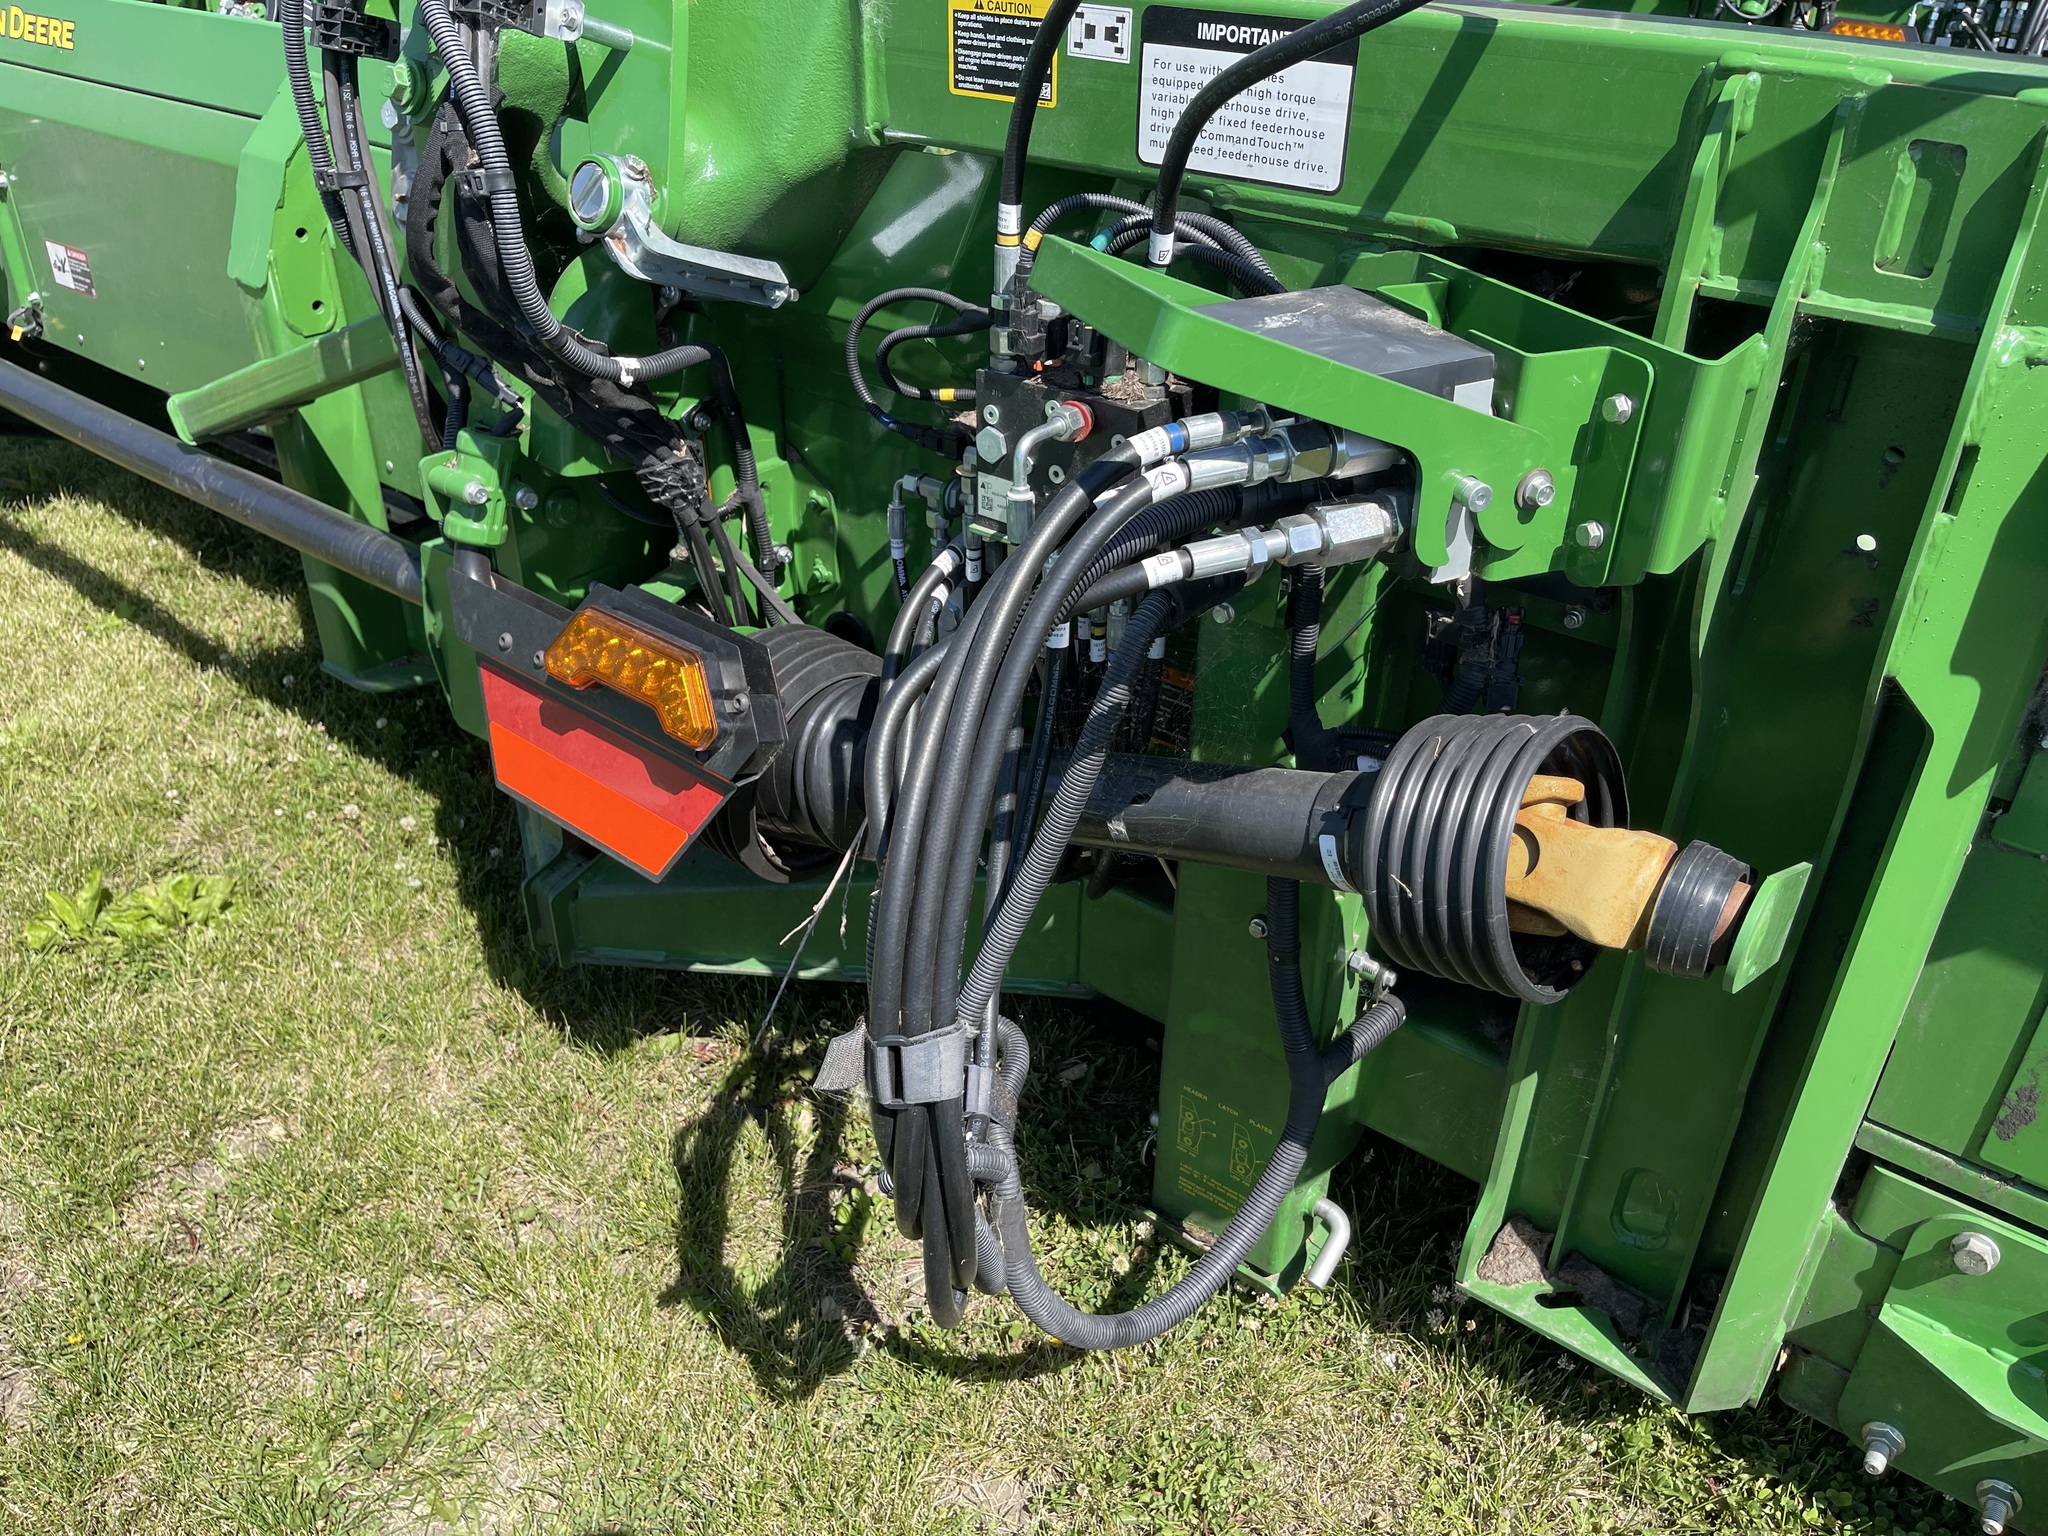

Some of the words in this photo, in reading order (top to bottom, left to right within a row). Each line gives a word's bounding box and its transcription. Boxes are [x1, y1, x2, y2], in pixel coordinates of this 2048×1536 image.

[987, 0, 1032, 15] CAUTION
[9, 5, 76, 51] DEERE
[1014, 18, 1030, 27] during
[958, 39, 987, 48] power-driven
[1006, 35, 1026, 45] clothing
[958, 48, 981, 57] Disengage
[982, 51, 1012, 60] power-driven
[1012, 53, 1024, 62] parts
[965, 57, 980, 65] engine
[981, 58, 995, 66] before
[996, 60, 1022, 70] unclogging
[1153, 58, 1172, 71] For
[1176, 63, 1195, 74] use
[1200, 64, 1224, 76] with
[958, 82, 984, 90] unattended.
[985, 78, 1003, 87] running
[1004, 80, 1019, 88] machin
[1152, 75, 1204, 91] equipped
[1246, 87, 1272, 102] high
[1277, 90, 1316, 106] torque
[1222, 100, 1271, 117] erhouse
[1275, 104, 1310, 123] drive,
[1150, 106, 1175, 121] high
[1218, 115, 1247, 130] fixed
[1251, 119, 1326, 140] feederhouse
[1218, 147, 1290, 169] feederhouse
[1293, 159, 1328, 174] drive.
[1183, 1085, 1208, 1101] HEADER
[1217, 1102, 1239, 1117] LATCH
[1248, 1118, 1273, 1135] PLATES
